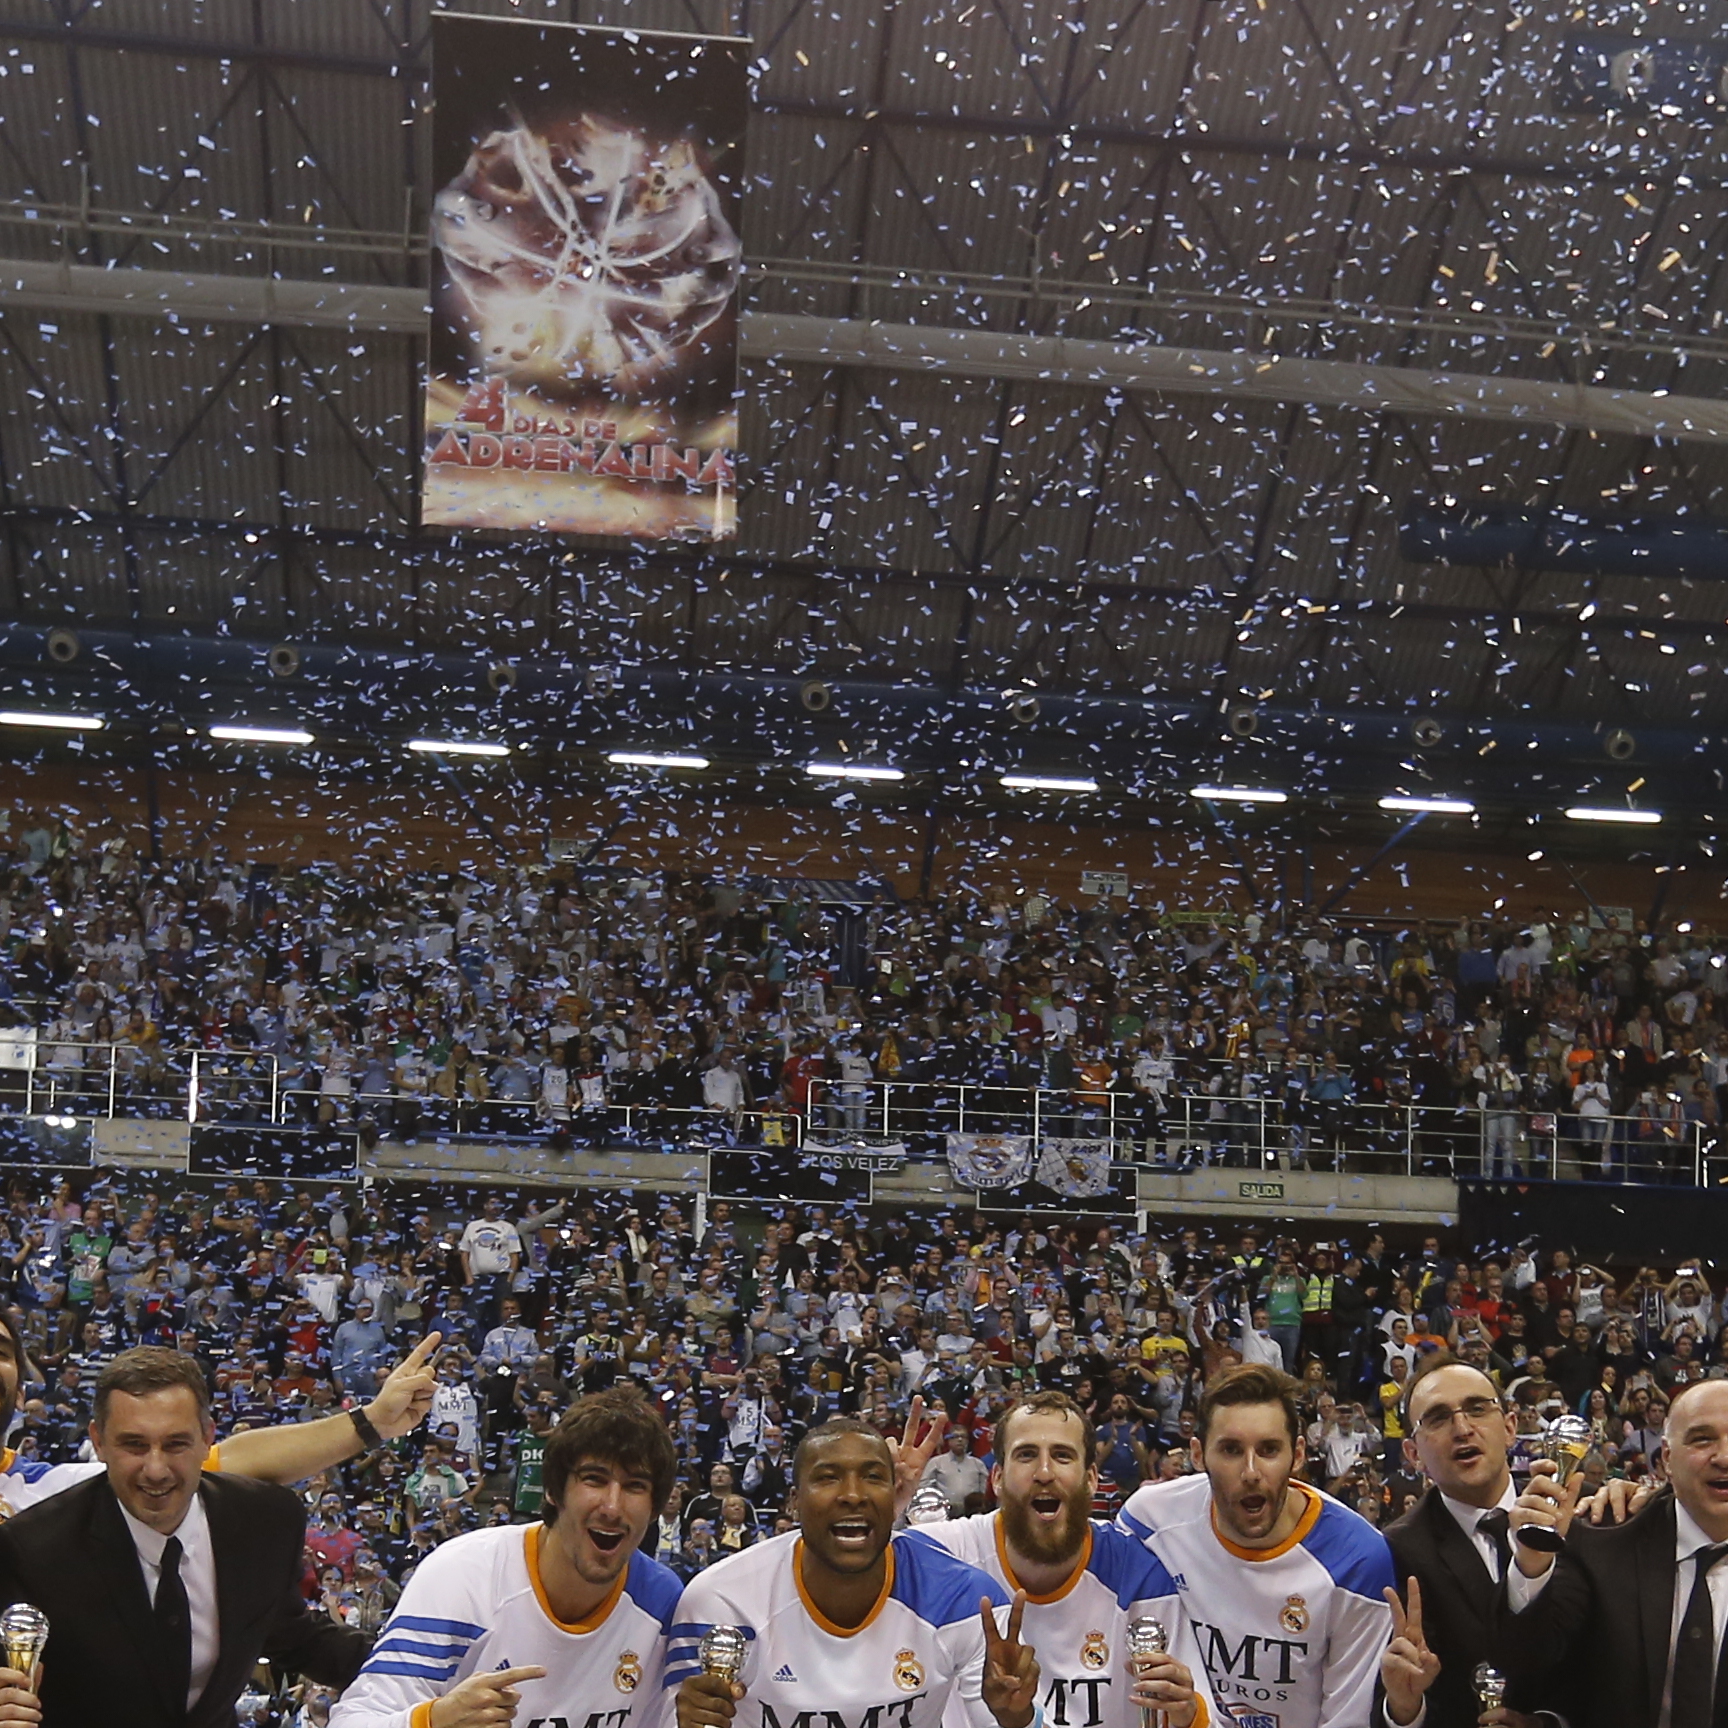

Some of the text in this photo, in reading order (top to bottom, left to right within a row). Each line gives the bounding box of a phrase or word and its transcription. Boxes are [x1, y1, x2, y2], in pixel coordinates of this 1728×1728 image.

[454, 377, 508, 433] 4
[583, 419, 617, 440] DE
[428, 430, 736, 484] ADRENALINA
[1241, 1185, 1283, 1197] SALIDA
[521, 1449, 545, 1461] DK
